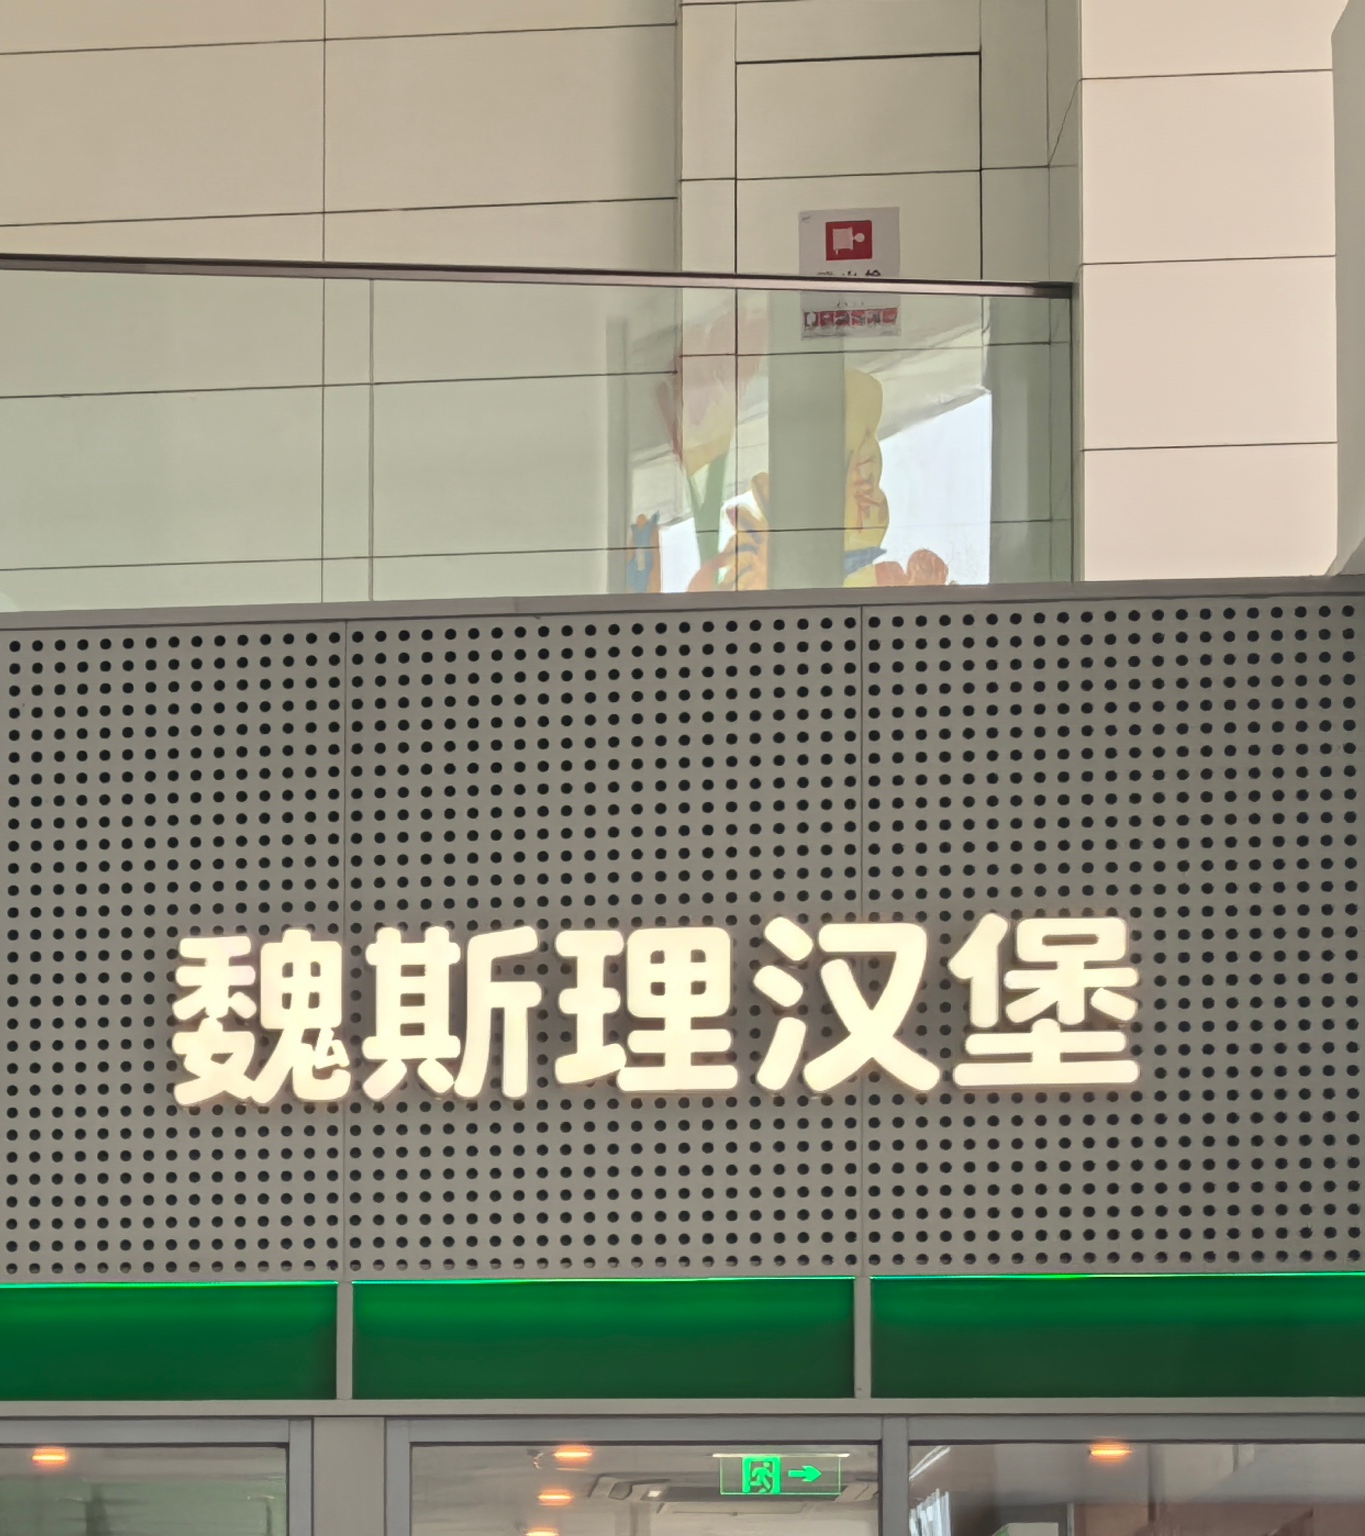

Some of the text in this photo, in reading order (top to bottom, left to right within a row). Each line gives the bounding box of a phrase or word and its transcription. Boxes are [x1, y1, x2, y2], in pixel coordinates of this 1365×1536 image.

[173, 914, 1138, 1104] 魏斯理汉堡
